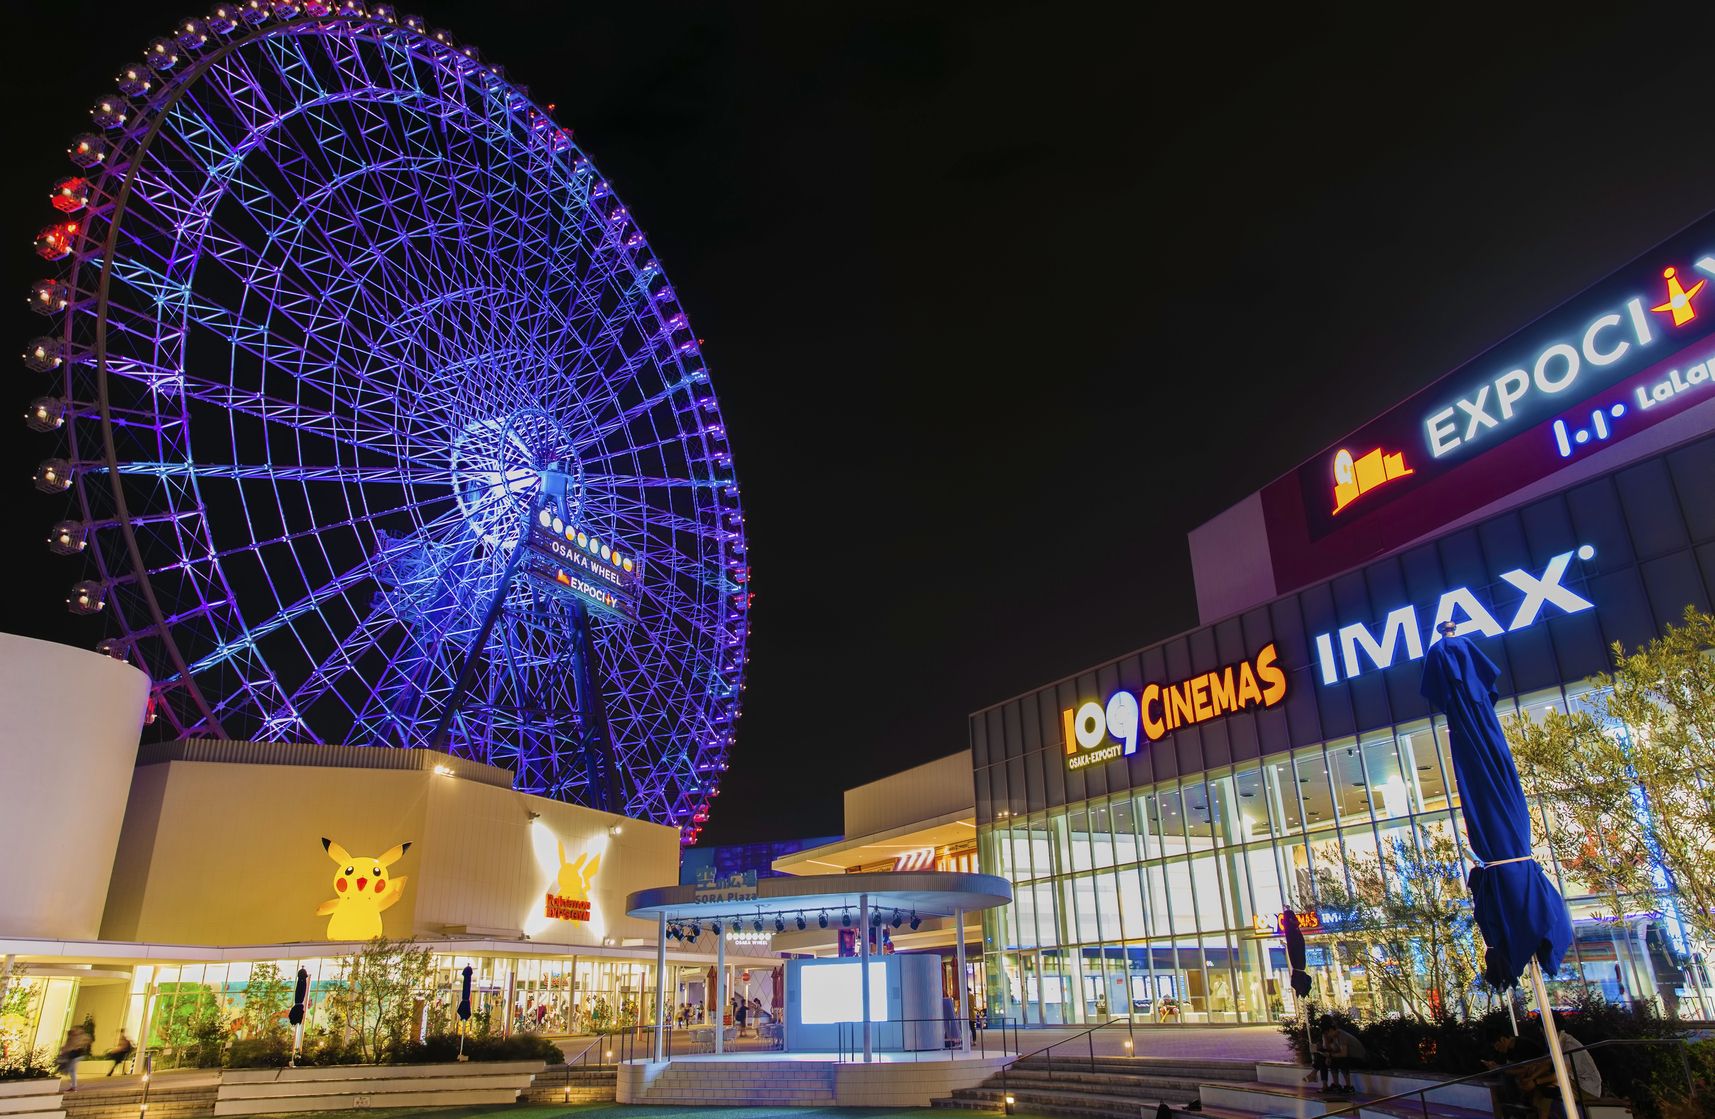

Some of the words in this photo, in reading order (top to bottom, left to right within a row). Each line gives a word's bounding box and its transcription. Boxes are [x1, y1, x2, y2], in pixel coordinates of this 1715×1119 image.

[551, 541, 588, 569] OSAKA
[590, 561, 624, 587] WHEEL
[1316, 550, 1595, 686] IMAX
[1064, 691, 1139, 756] 109
[1141, 643, 1287, 740] CINEMAS
[695, 894, 723, 904] SORA
[727, 892, 757, 902] Plaza
